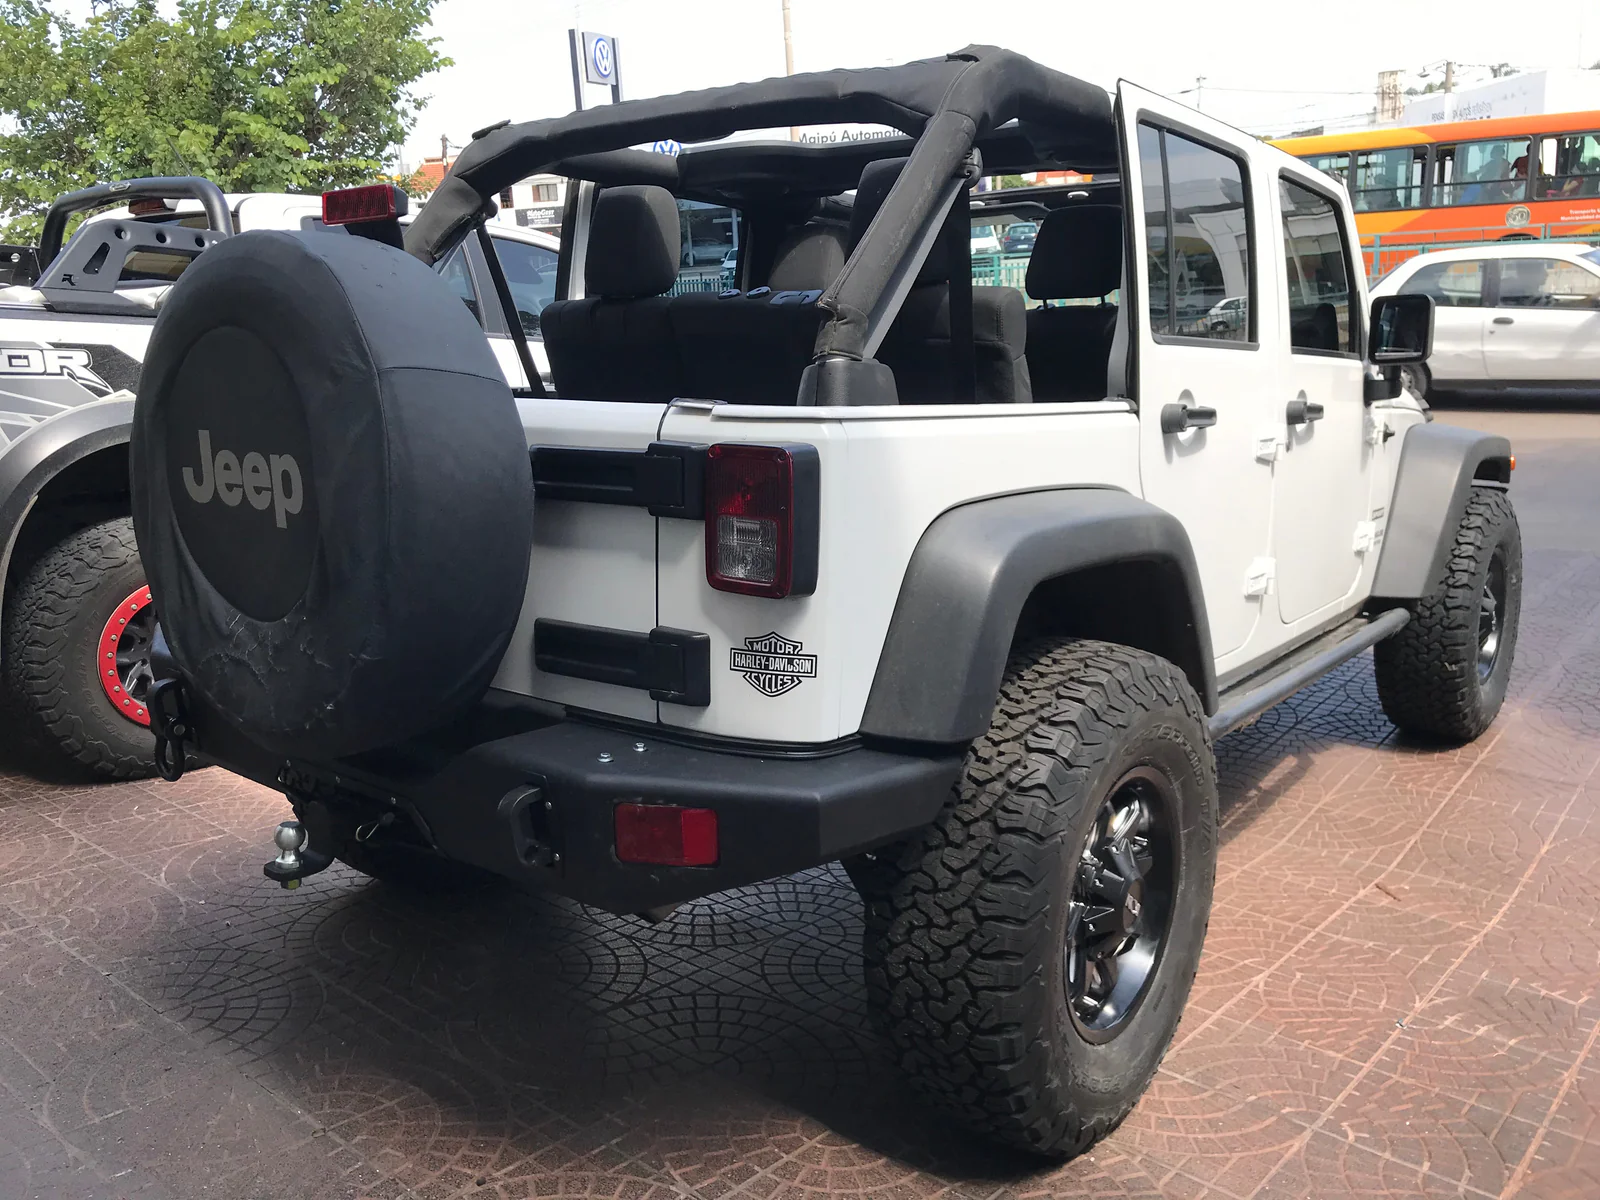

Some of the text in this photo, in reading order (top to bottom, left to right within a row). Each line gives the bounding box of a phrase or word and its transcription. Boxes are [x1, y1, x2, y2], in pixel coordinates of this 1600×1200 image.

[595, 39, 612, 77] VW
[799, 130, 837, 144] Maipú
[182, 429, 304, 529] Jeep
[752, 638, 794, 655] MOTOR
[751, 672, 792, 693] CYCLES
